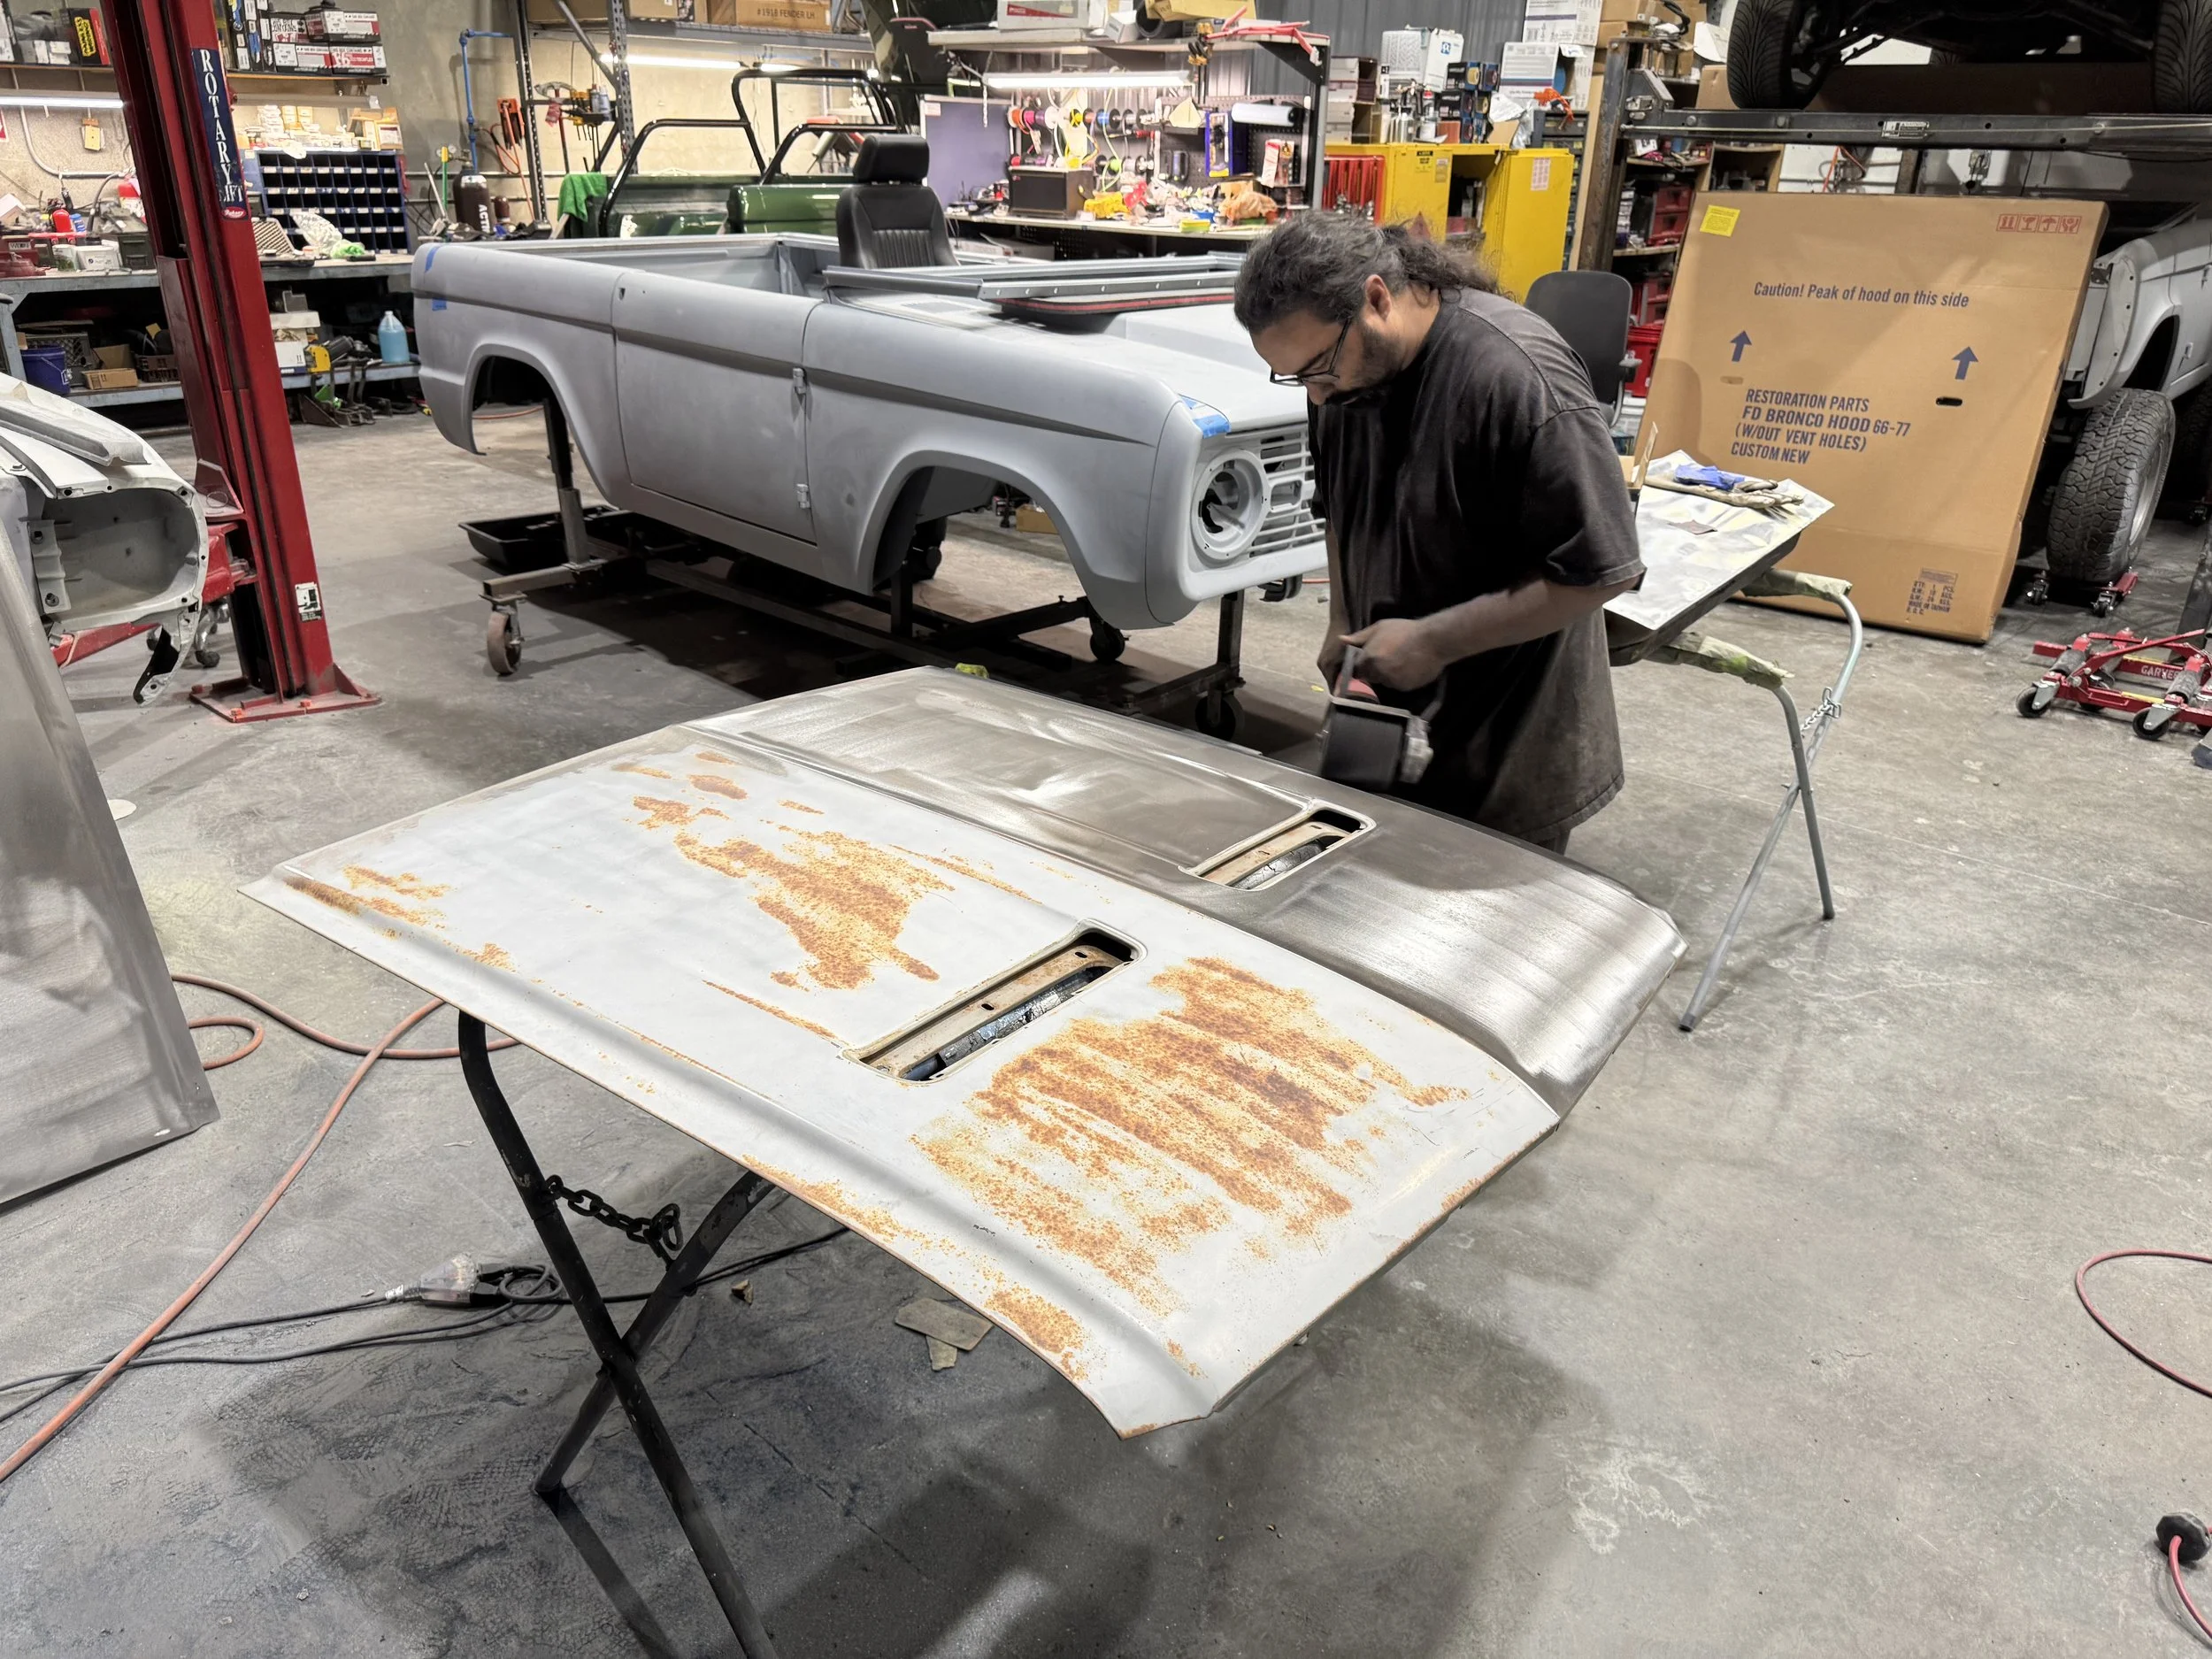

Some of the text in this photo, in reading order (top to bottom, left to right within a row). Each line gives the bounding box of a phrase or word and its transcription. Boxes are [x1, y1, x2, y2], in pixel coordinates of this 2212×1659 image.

[200, 50, 232, 185] ROTARY
[1754, 281, 1970, 307] Caution! Peak of hood on this side
[1746, 388, 1870, 412] RESTORATION PARTS
[1742, 406, 1911, 436] FD BRONCO HOOD 66-77
[1731, 442, 1810, 464] CUSTOM NEW
[1786, 429, 1816, 446] VENT
[1818, 432, 1867, 452] HOLES)
